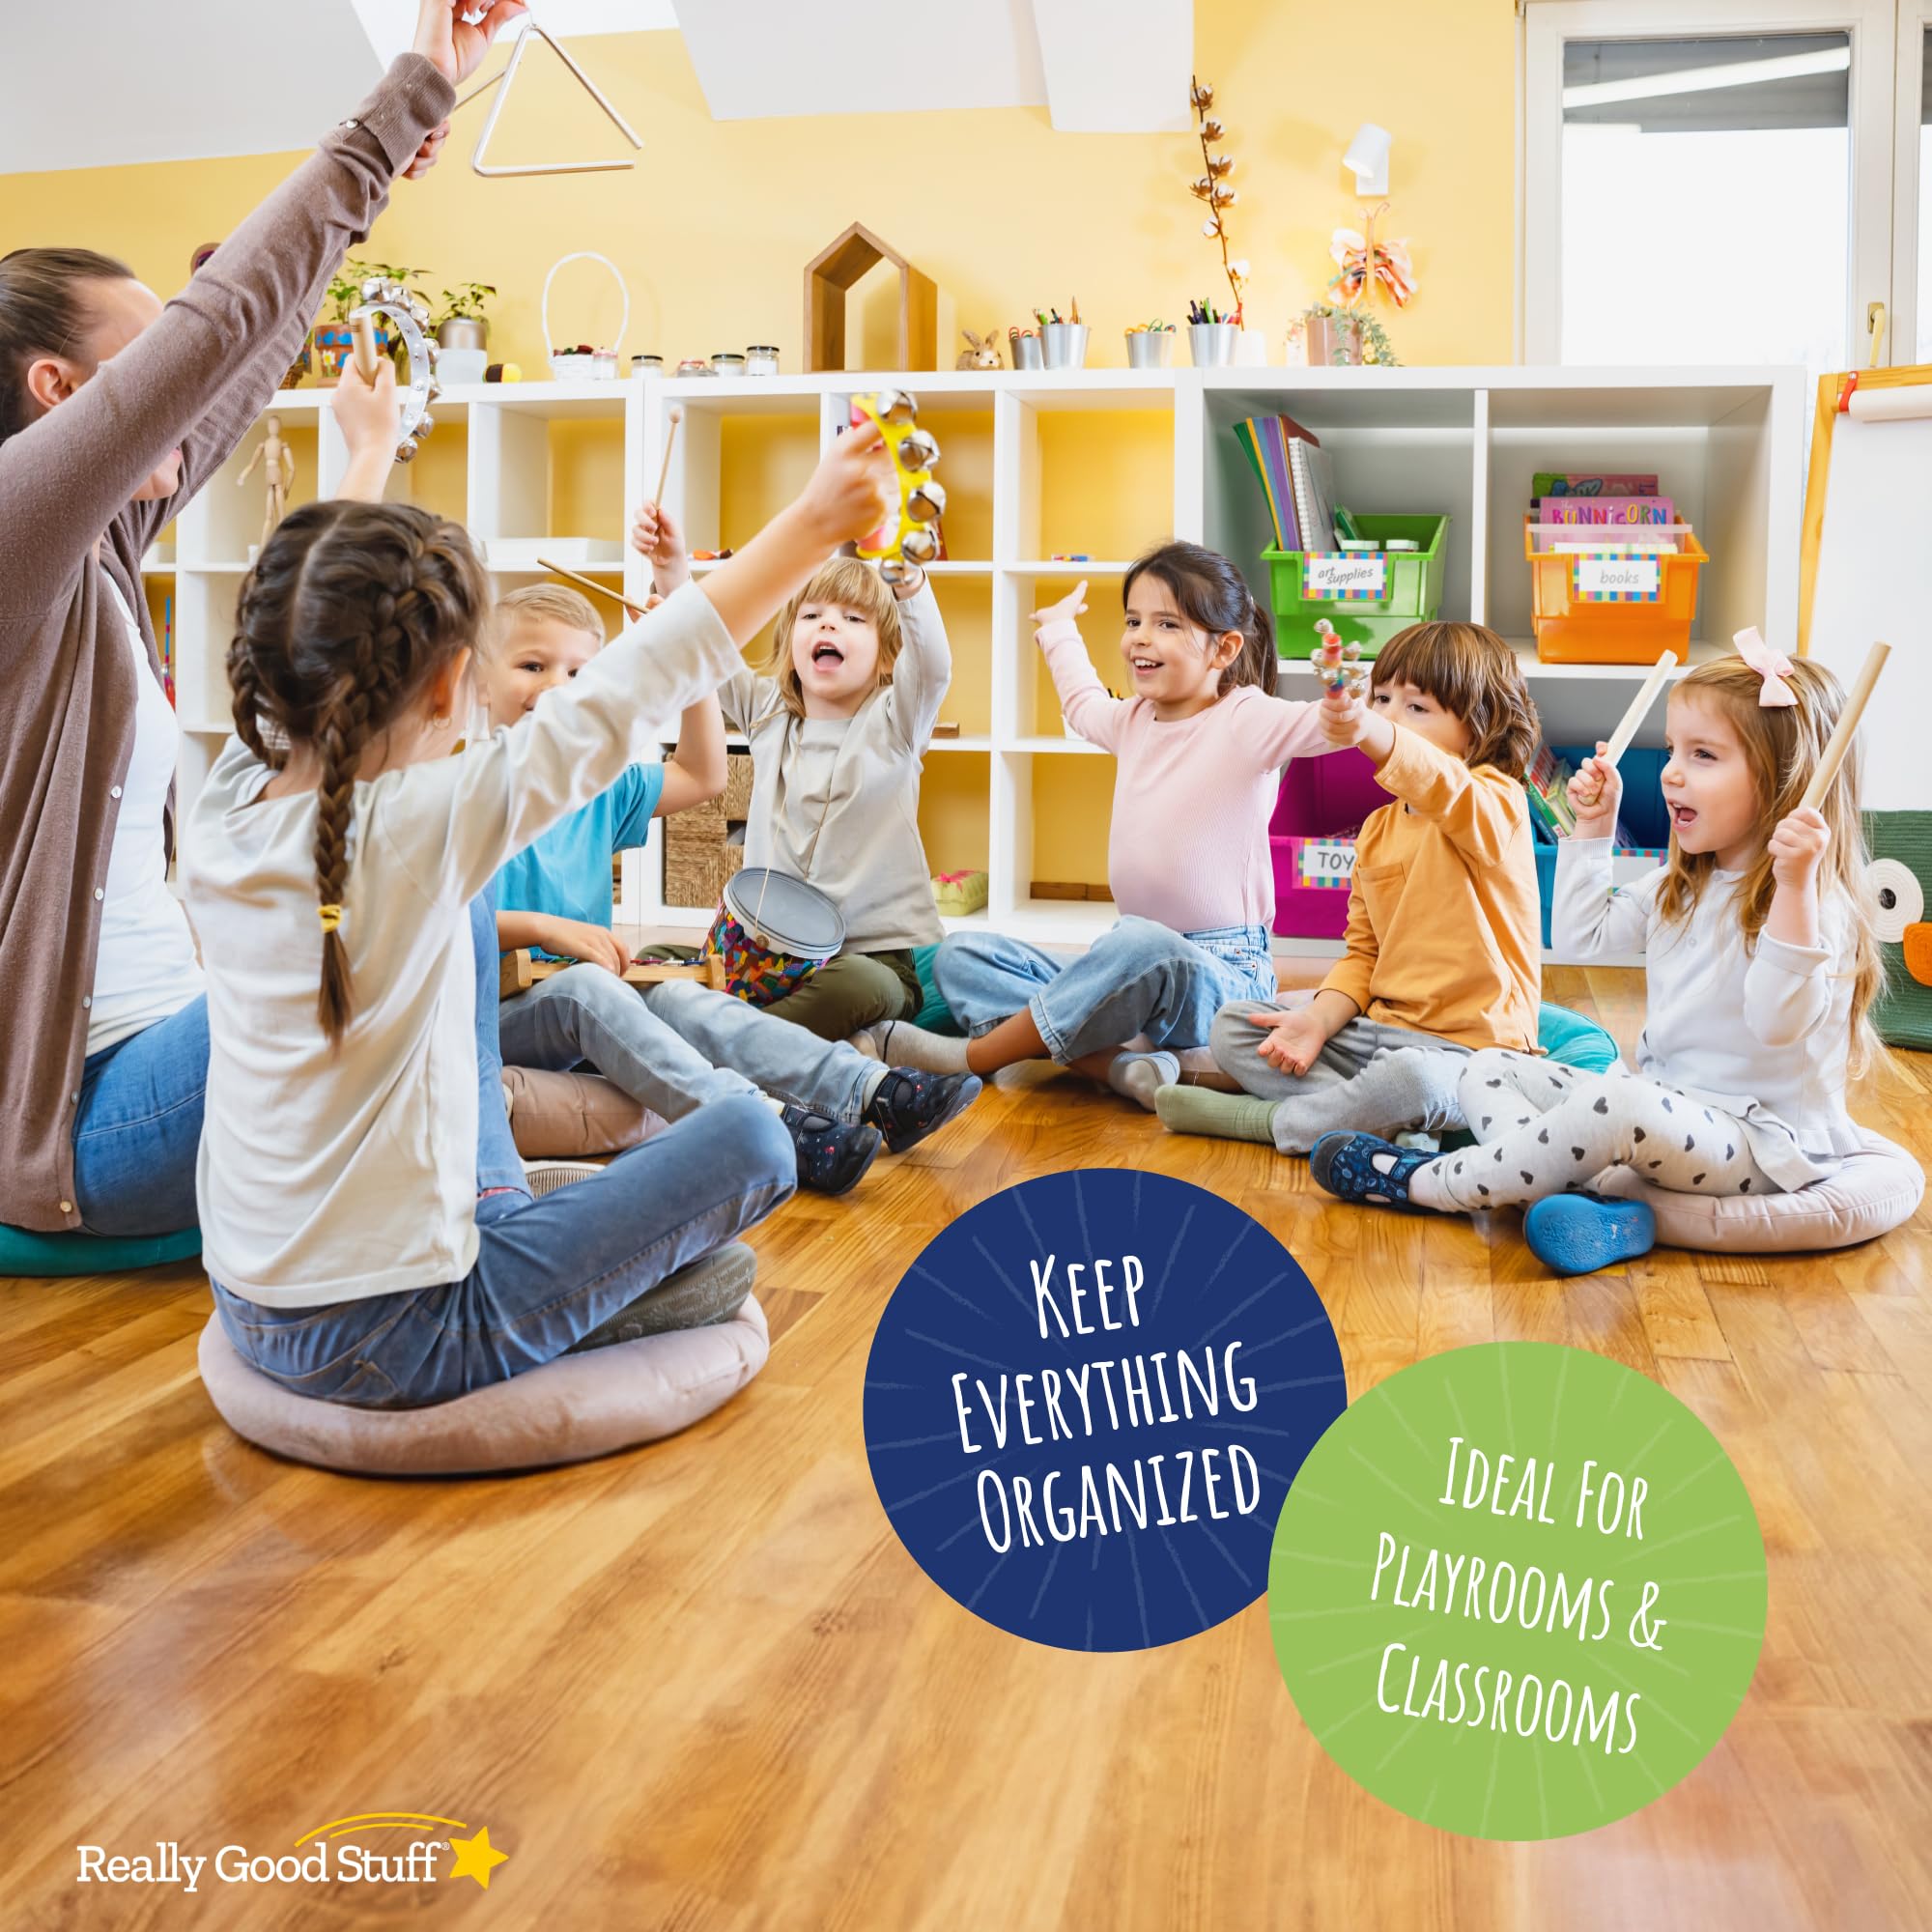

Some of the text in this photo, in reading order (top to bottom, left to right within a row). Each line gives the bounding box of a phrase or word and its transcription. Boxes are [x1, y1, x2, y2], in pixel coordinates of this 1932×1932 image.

[1318, 567, 1335, 579] art
[1326, 568, 1374, 585] supplies
[1600, 570, 1639, 584] books
[1317, 851, 1354, 871] TOY
